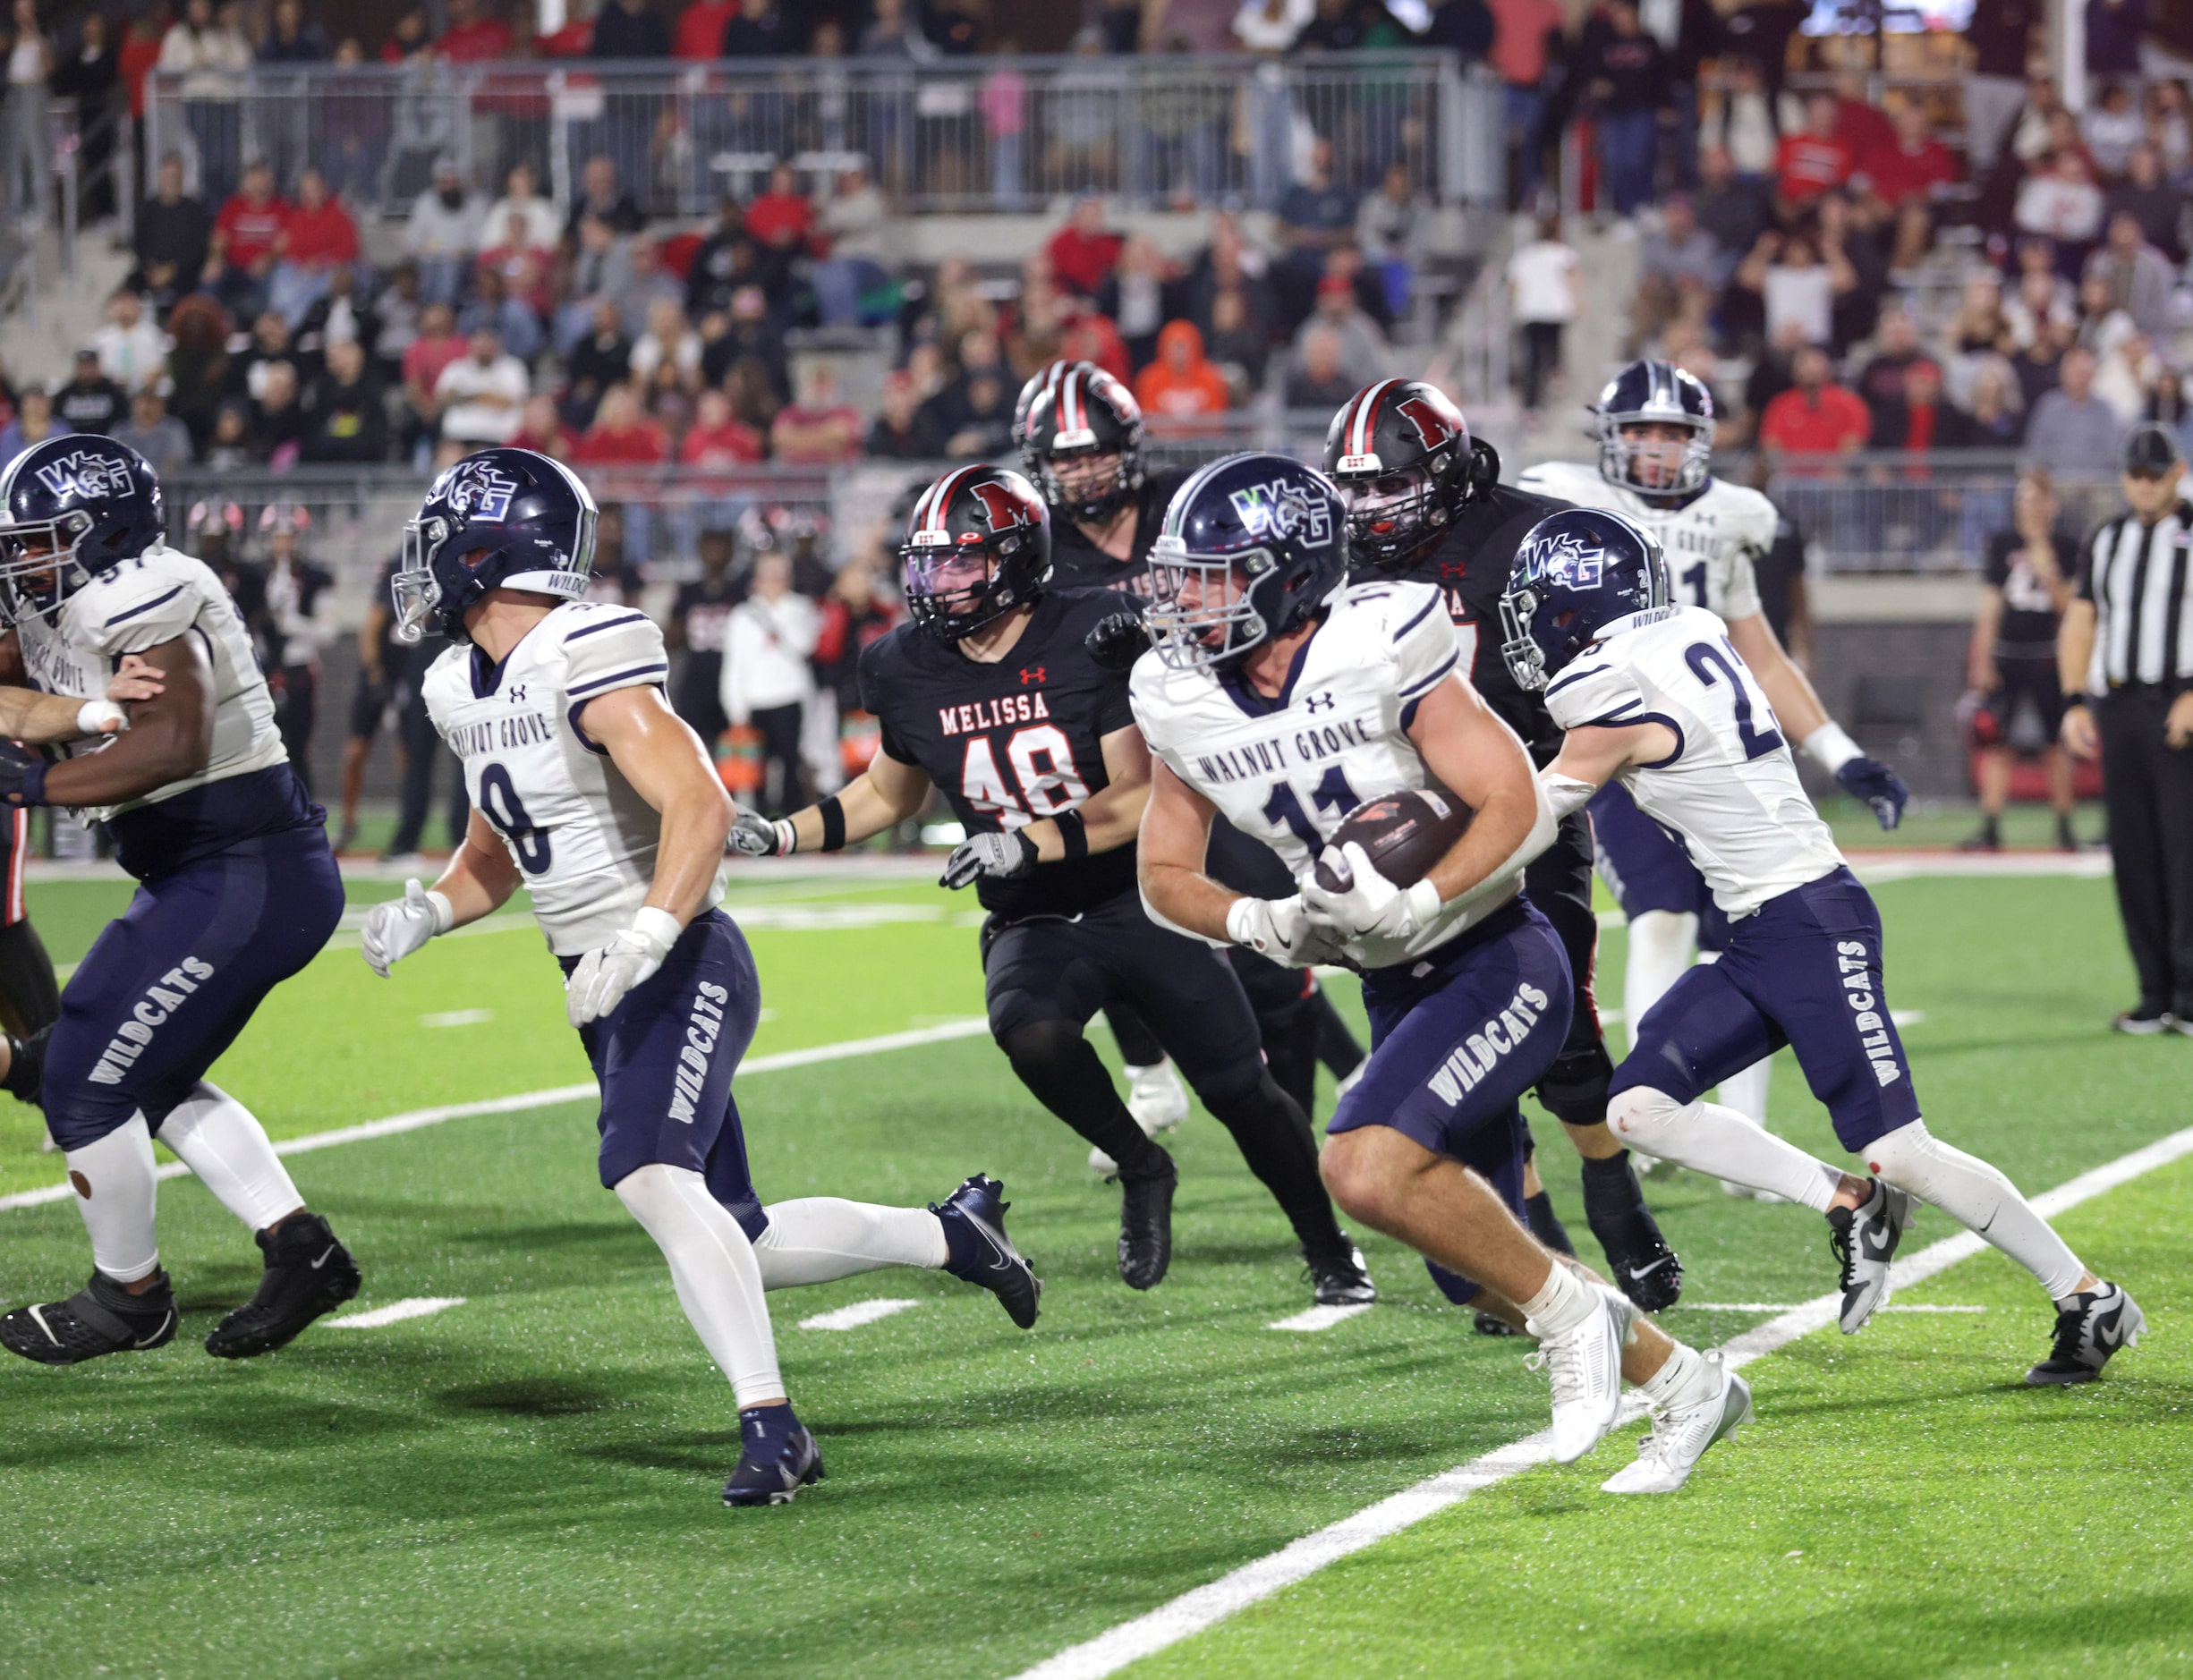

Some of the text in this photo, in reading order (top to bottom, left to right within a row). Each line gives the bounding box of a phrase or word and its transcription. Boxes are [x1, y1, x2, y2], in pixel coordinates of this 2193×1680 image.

[501, 713, 553, 749] GROVE
[939, 691, 1050, 736] MELISSA
[1198, 718, 1371, 784] WALNUT GROVE
[961, 721, 1093, 834] 48
[88, 955, 215, 1085] WILDCATS
[667, 980, 729, 1124] WILDCATS
[1427, 982, 1548, 1107] WILDCATS
[1836, 941, 1901, 1088] WILDCATS
